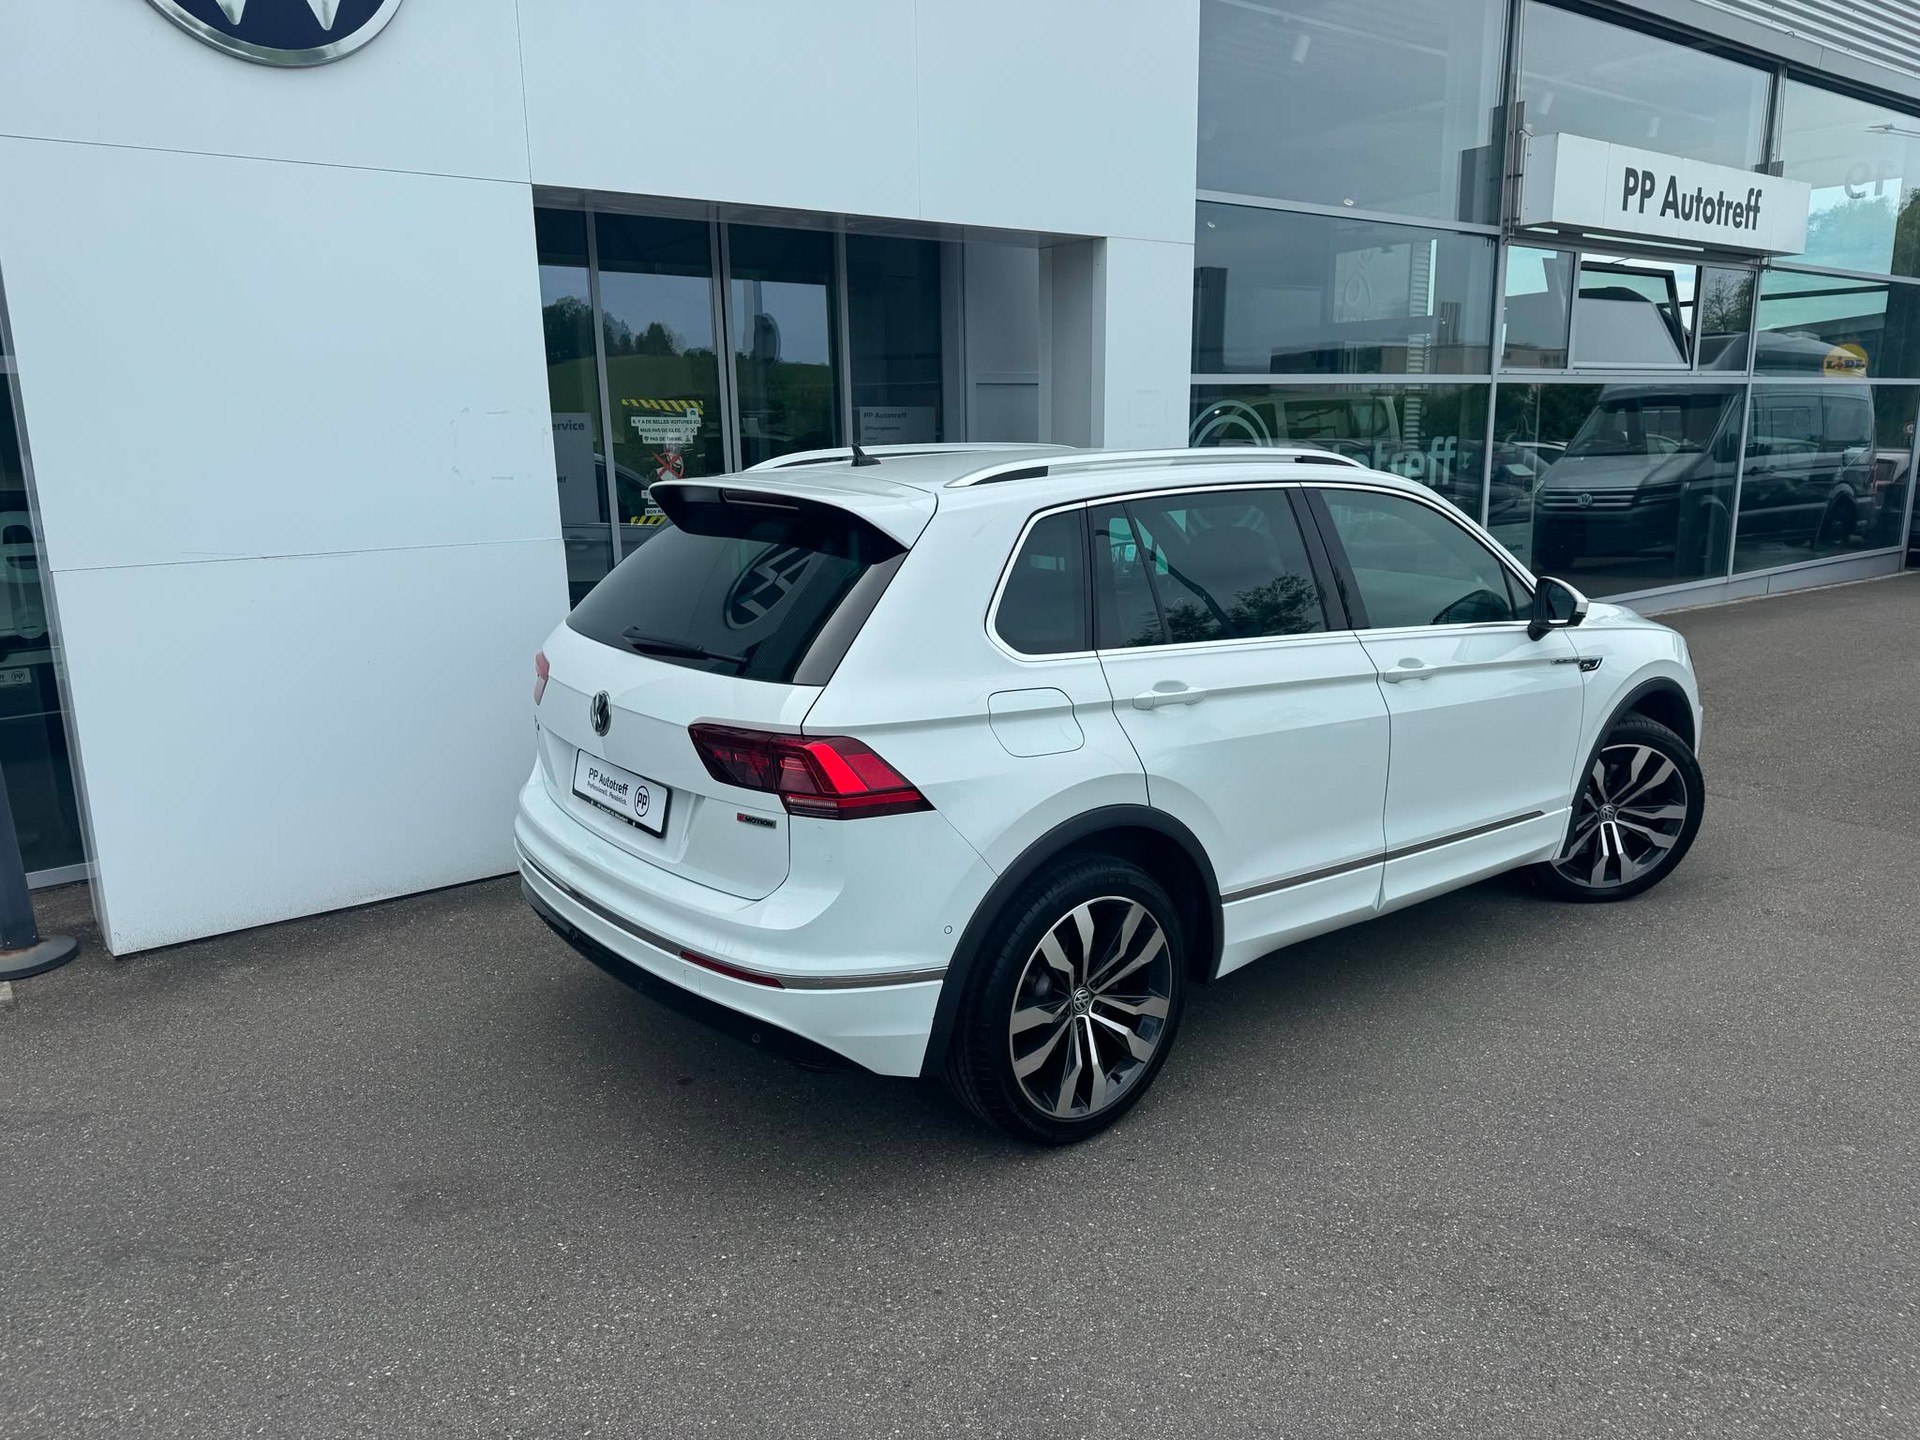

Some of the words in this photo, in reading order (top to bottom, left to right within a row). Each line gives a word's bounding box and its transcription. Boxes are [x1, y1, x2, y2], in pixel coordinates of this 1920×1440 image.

[1621, 166, 1656, 214] PP
[1659, 175, 1763, 231] Autotreff
[552, 420, 585, 431] ervice
[588, 767, 599, 781] PP
[598, 773, 629, 796] Autotreff
[636, 792, 648, 810] PP
